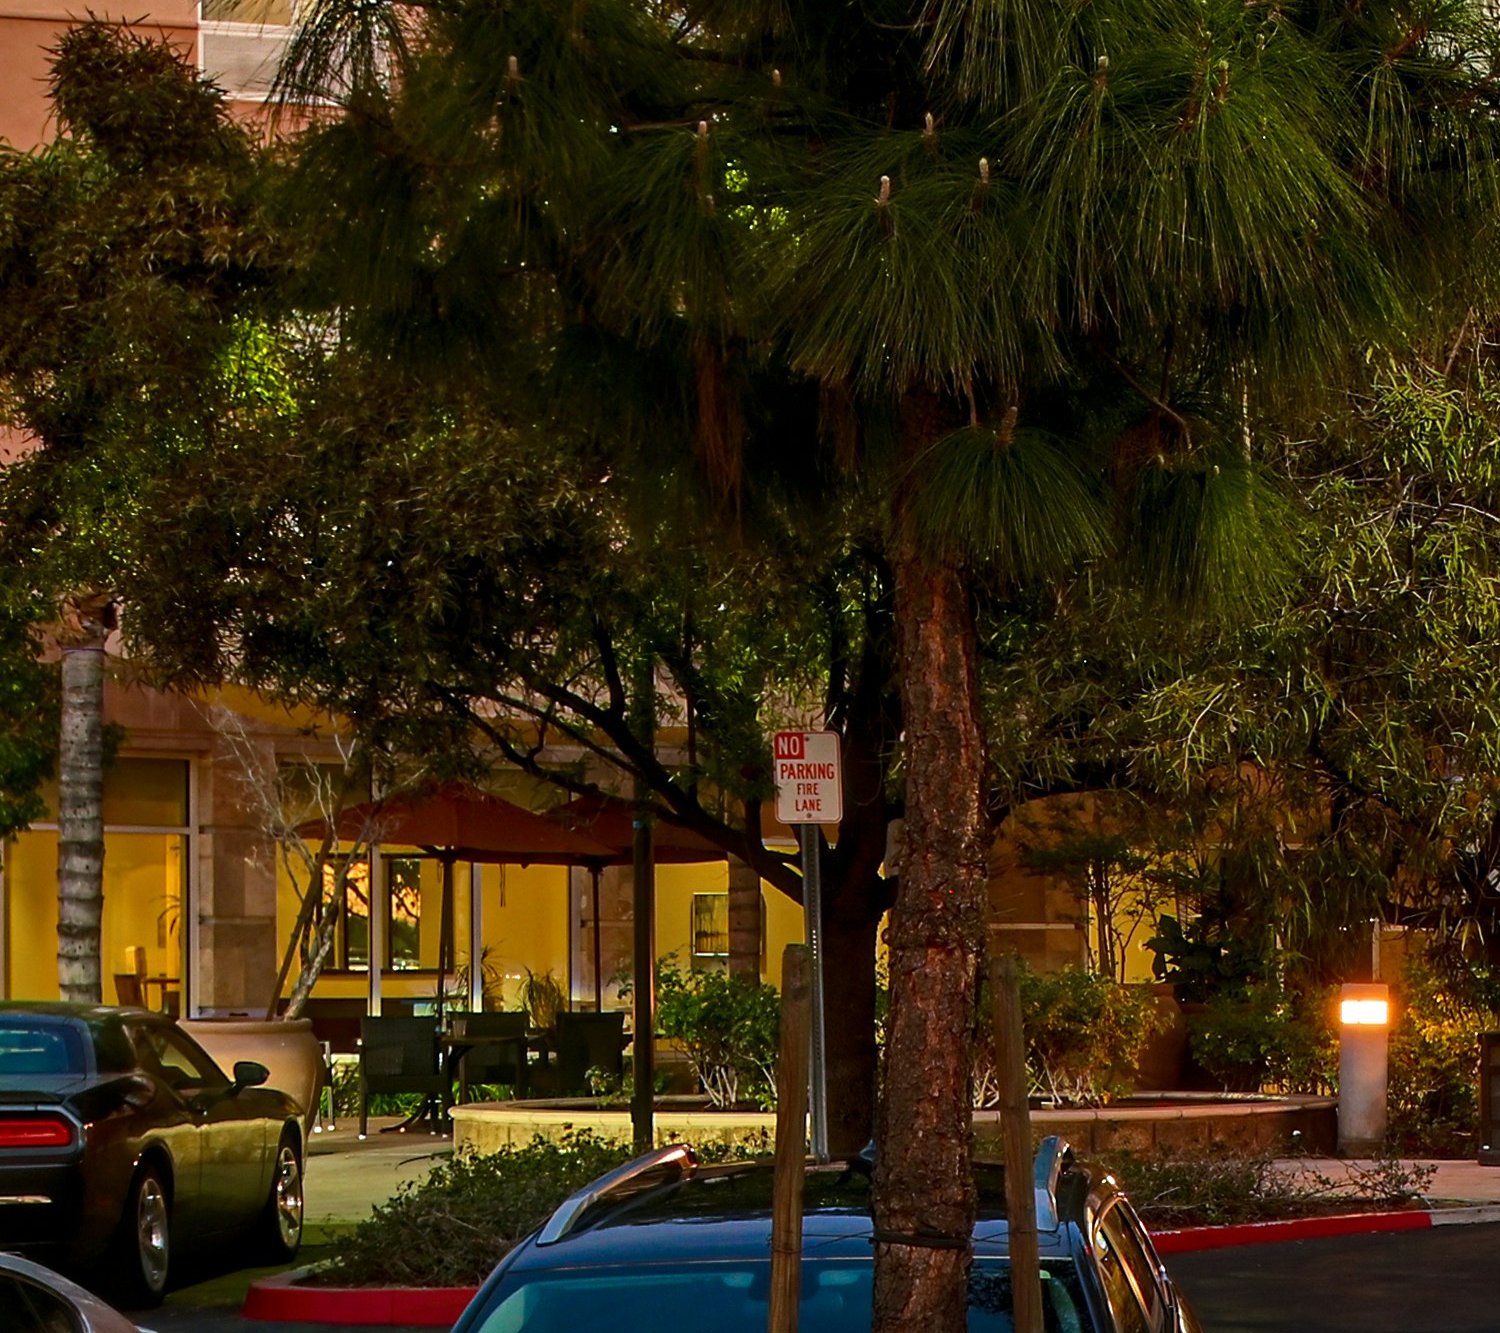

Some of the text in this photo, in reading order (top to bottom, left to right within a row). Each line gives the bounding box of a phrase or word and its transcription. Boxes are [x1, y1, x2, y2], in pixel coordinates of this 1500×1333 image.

[778, 736, 800, 756] NO
[780, 762, 835, 780] PARKING
[797, 783, 820, 796] FIRE
[795, 799, 822, 812] LANE
